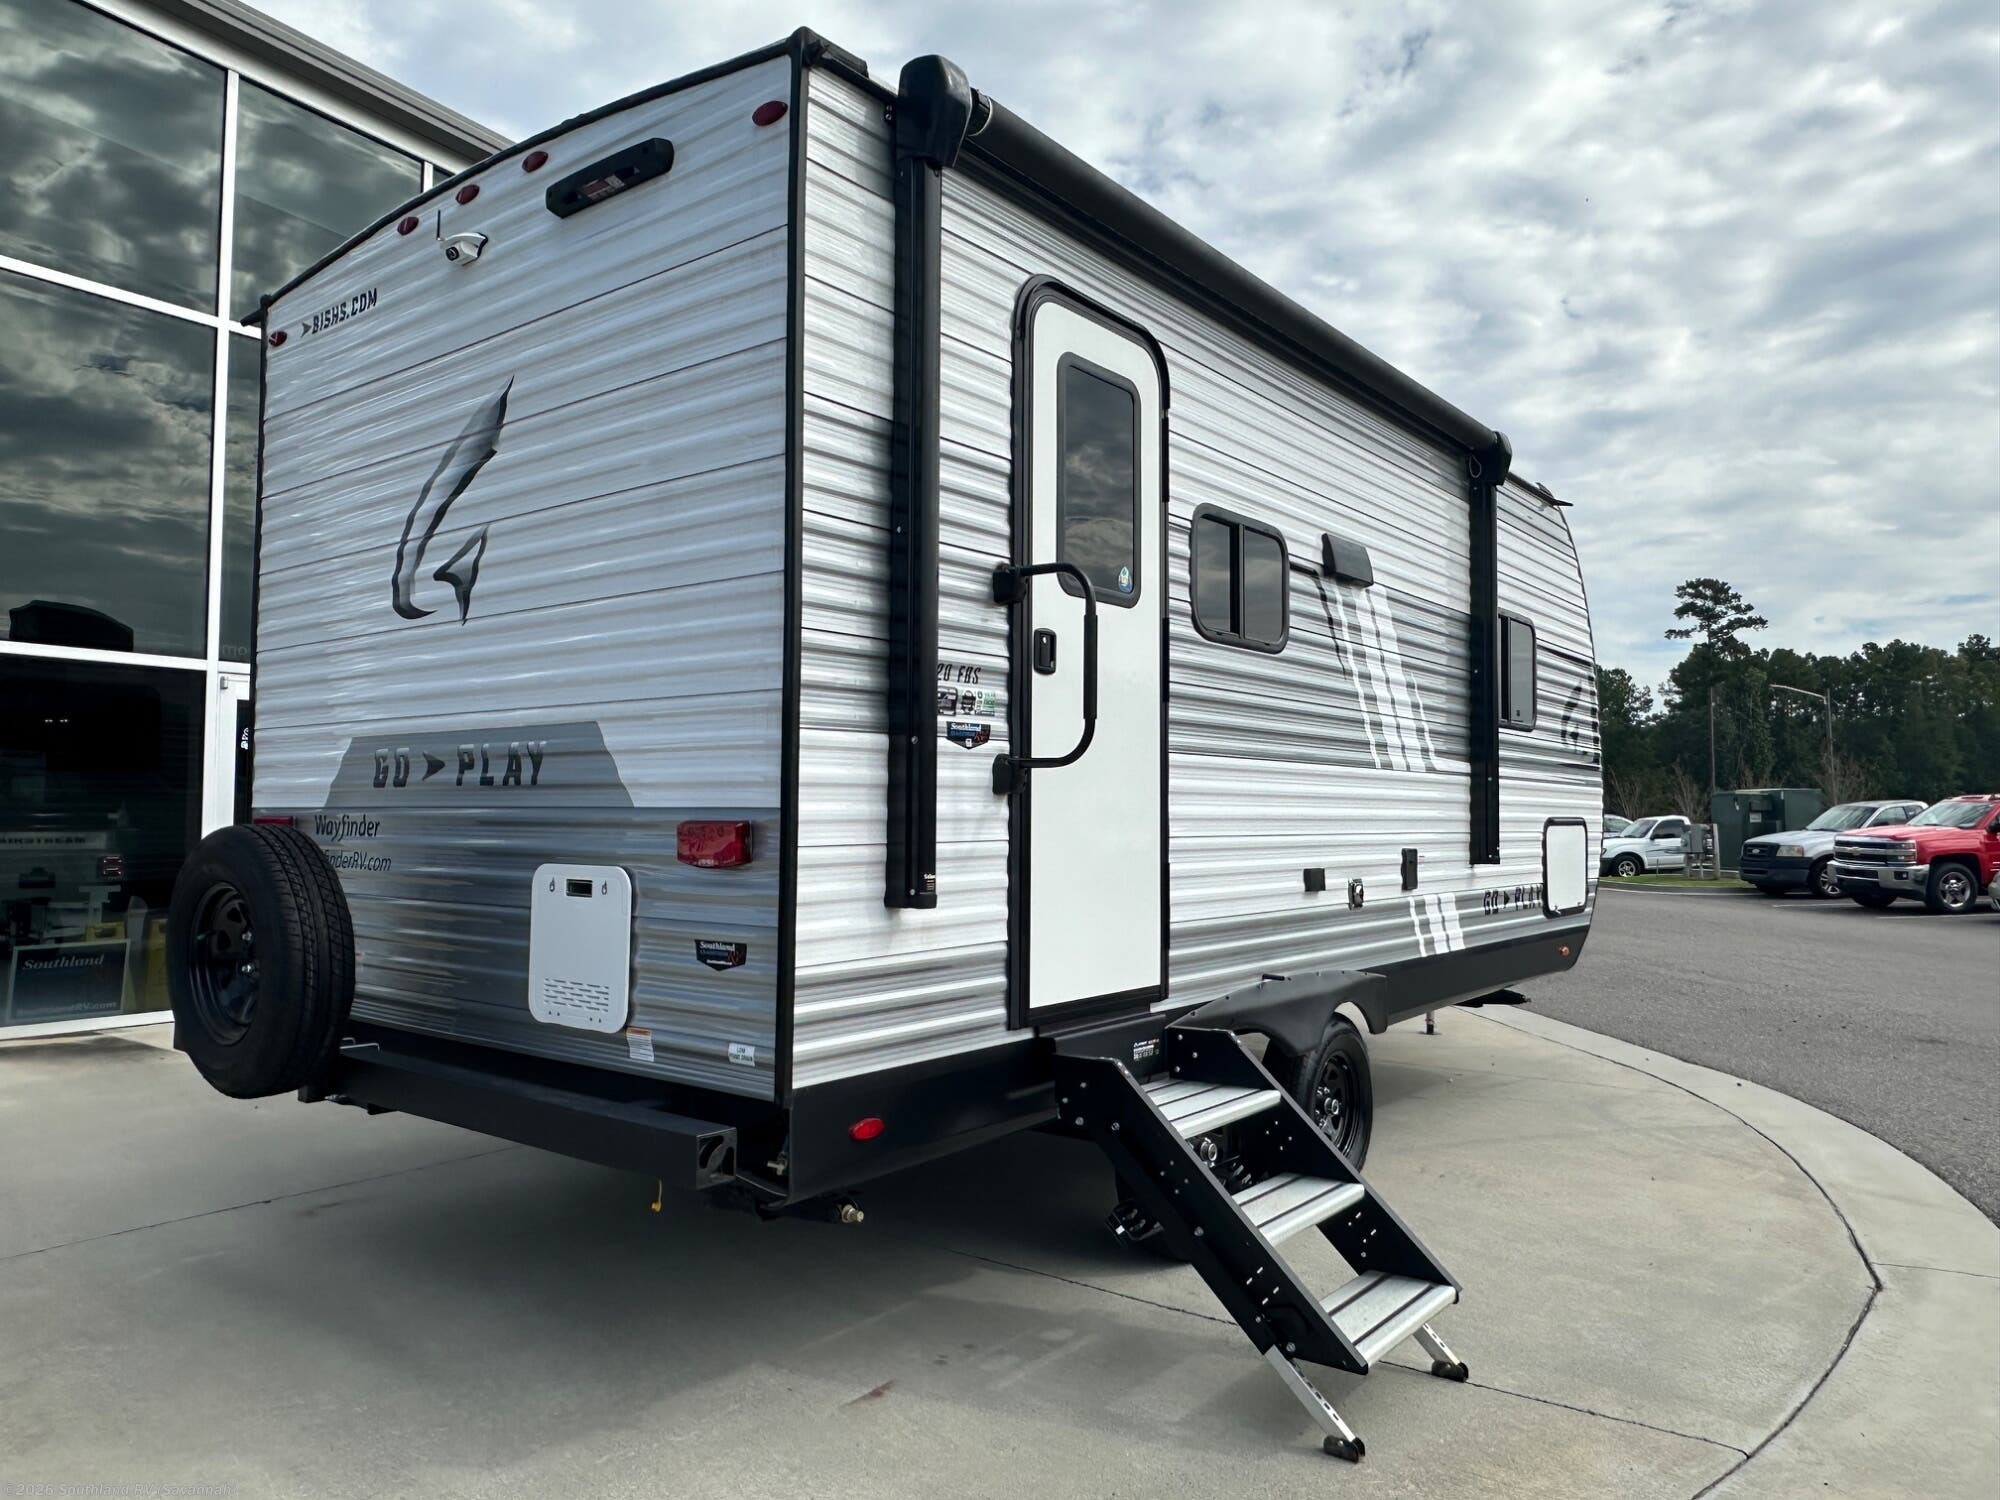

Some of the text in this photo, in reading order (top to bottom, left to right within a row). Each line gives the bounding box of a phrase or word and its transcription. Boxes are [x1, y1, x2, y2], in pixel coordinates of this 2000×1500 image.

[311, 287, 378, 334] BISHS.COM
[373, 740, 547, 788] GO PLAY
[314, 813, 380, 841] Wayfinder
[22, 954, 105, 970] Southland
